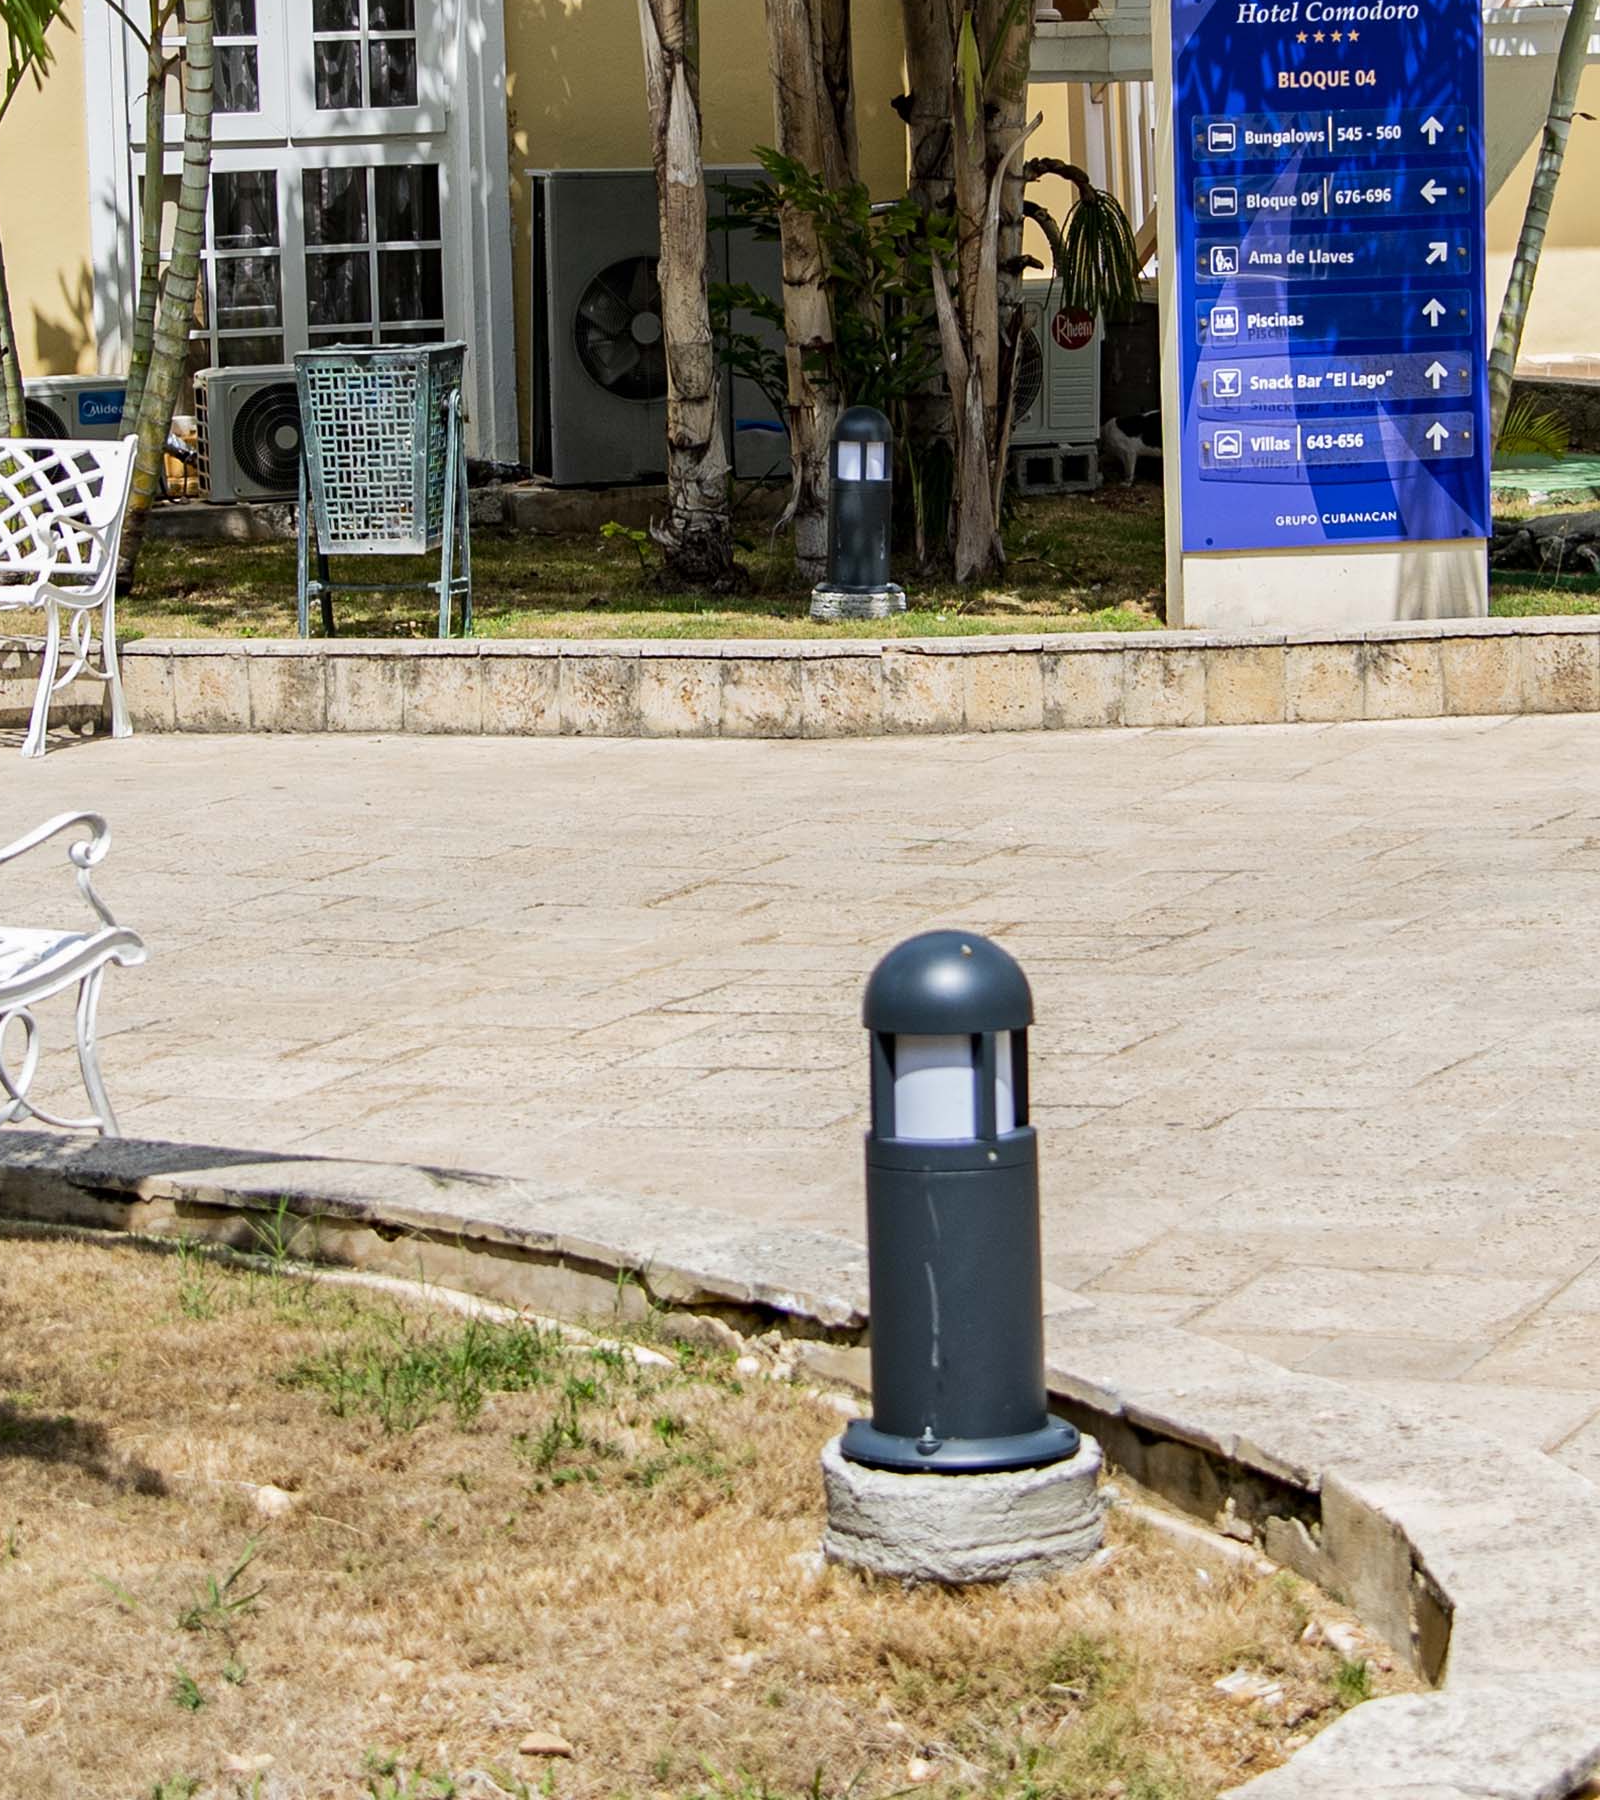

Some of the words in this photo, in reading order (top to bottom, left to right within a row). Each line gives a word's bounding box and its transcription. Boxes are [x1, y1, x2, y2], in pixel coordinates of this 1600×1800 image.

[1236, 1, 1299, 24] Hotel
[1305, 0, 1420, 22] Comodoro
[1278, 70, 1350, 90] BLOQUE
[1355, 69, 1377, 86] 04
[1244, 128, 1325, 147] Bungalows
[1337, 127, 1362, 142] 545
[1376, 125, 1402, 140] 560
[1246, 193, 1297, 211] Bloque
[1301, 192, 1319, 206] 09
[1335, 188, 1392, 204] 676-696
[1248, 251, 1282, 265] Ama
[1286, 250, 1305, 264] de
[1309, 249, 1354, 264] Llaves
[1247, 312, 1304, 329] Piscinas
[1250, 374, 1293, 390] Snack
[1297, 374, 1322, 388] Bar
[1250, 436, 1291, 451] Villas
[1306, 433, 1364, 450] 643-656
[1275, 514, 1318, 527] GRUPO
[1322, 511, 1397, 525] CUBANACAN
